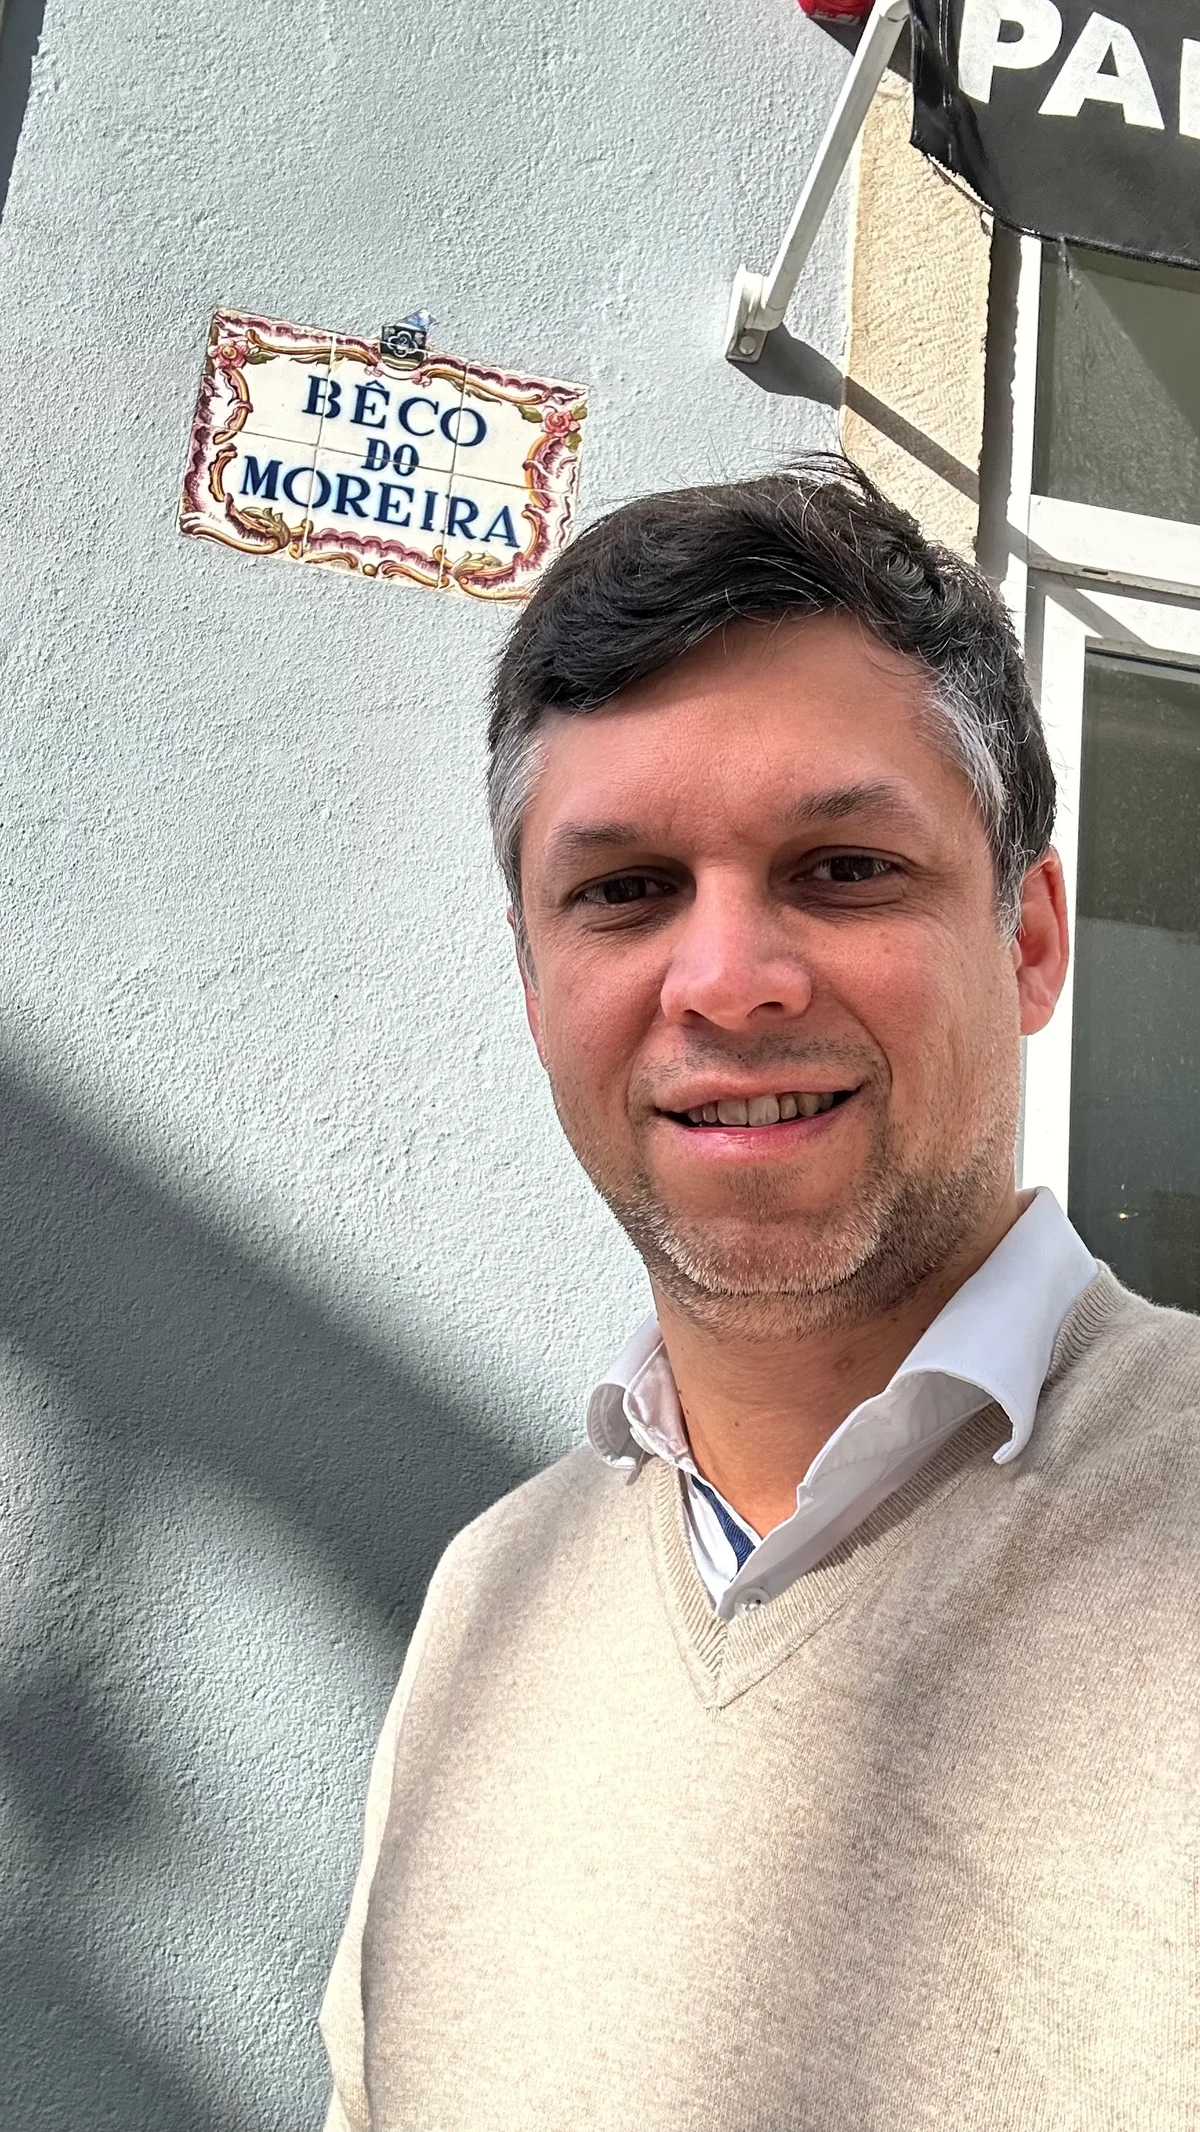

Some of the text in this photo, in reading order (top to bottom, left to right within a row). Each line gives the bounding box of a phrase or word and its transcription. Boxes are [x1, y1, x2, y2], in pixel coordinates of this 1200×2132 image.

[958, 0, 1200, 140] PA
[302, 375, 487, 447] BÊCO
[361, 438, 420, 477] DO
[239, 455, 521, 548] MOREIRA
